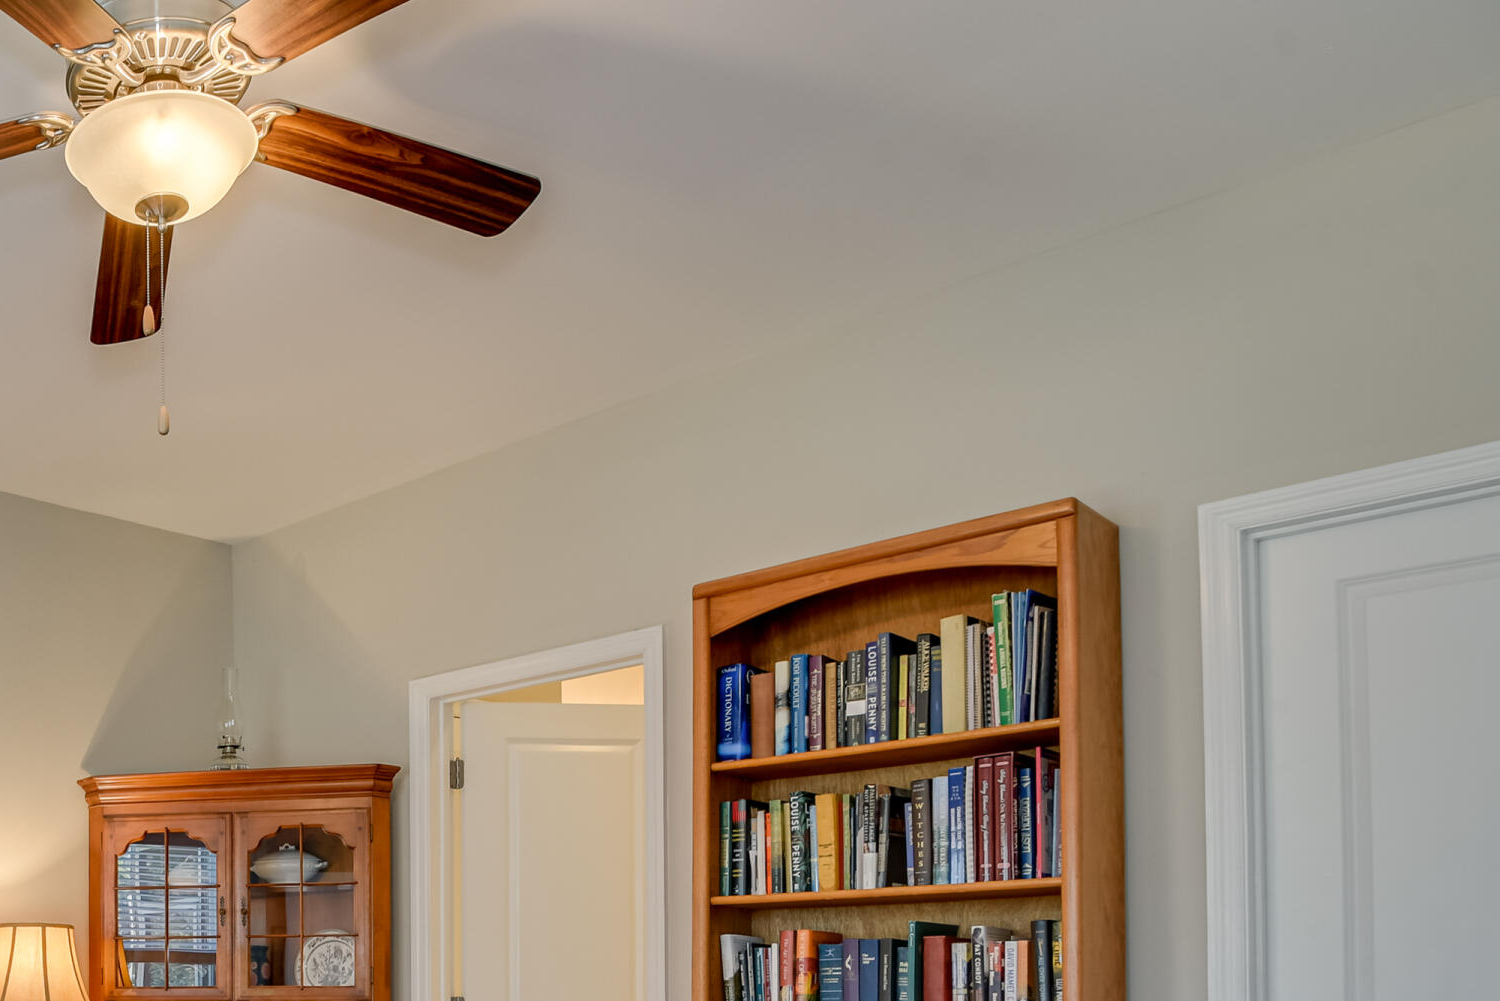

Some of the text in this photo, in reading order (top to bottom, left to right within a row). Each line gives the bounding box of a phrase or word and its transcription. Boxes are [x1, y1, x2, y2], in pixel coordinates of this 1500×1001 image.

[793, 656, 802, 675] JODI
[868, 646, 877, 683] LOUISE
[922, 641, 930, 692] ALICE WALKER
[725, 676, 733, 732] DICTIONARY
[793, 677, 802, 709] PICOULT
[868, 696, 877, 731] PENNY
[790, 796, 800, 878] LOUISE PENNY
[868, 822, 876, 841] PEACE
[974, 957, 982, 984] CONROY
[1007, 948, 1015, 968] DAVID
[1007, 969, 1015, 993] MAMET
